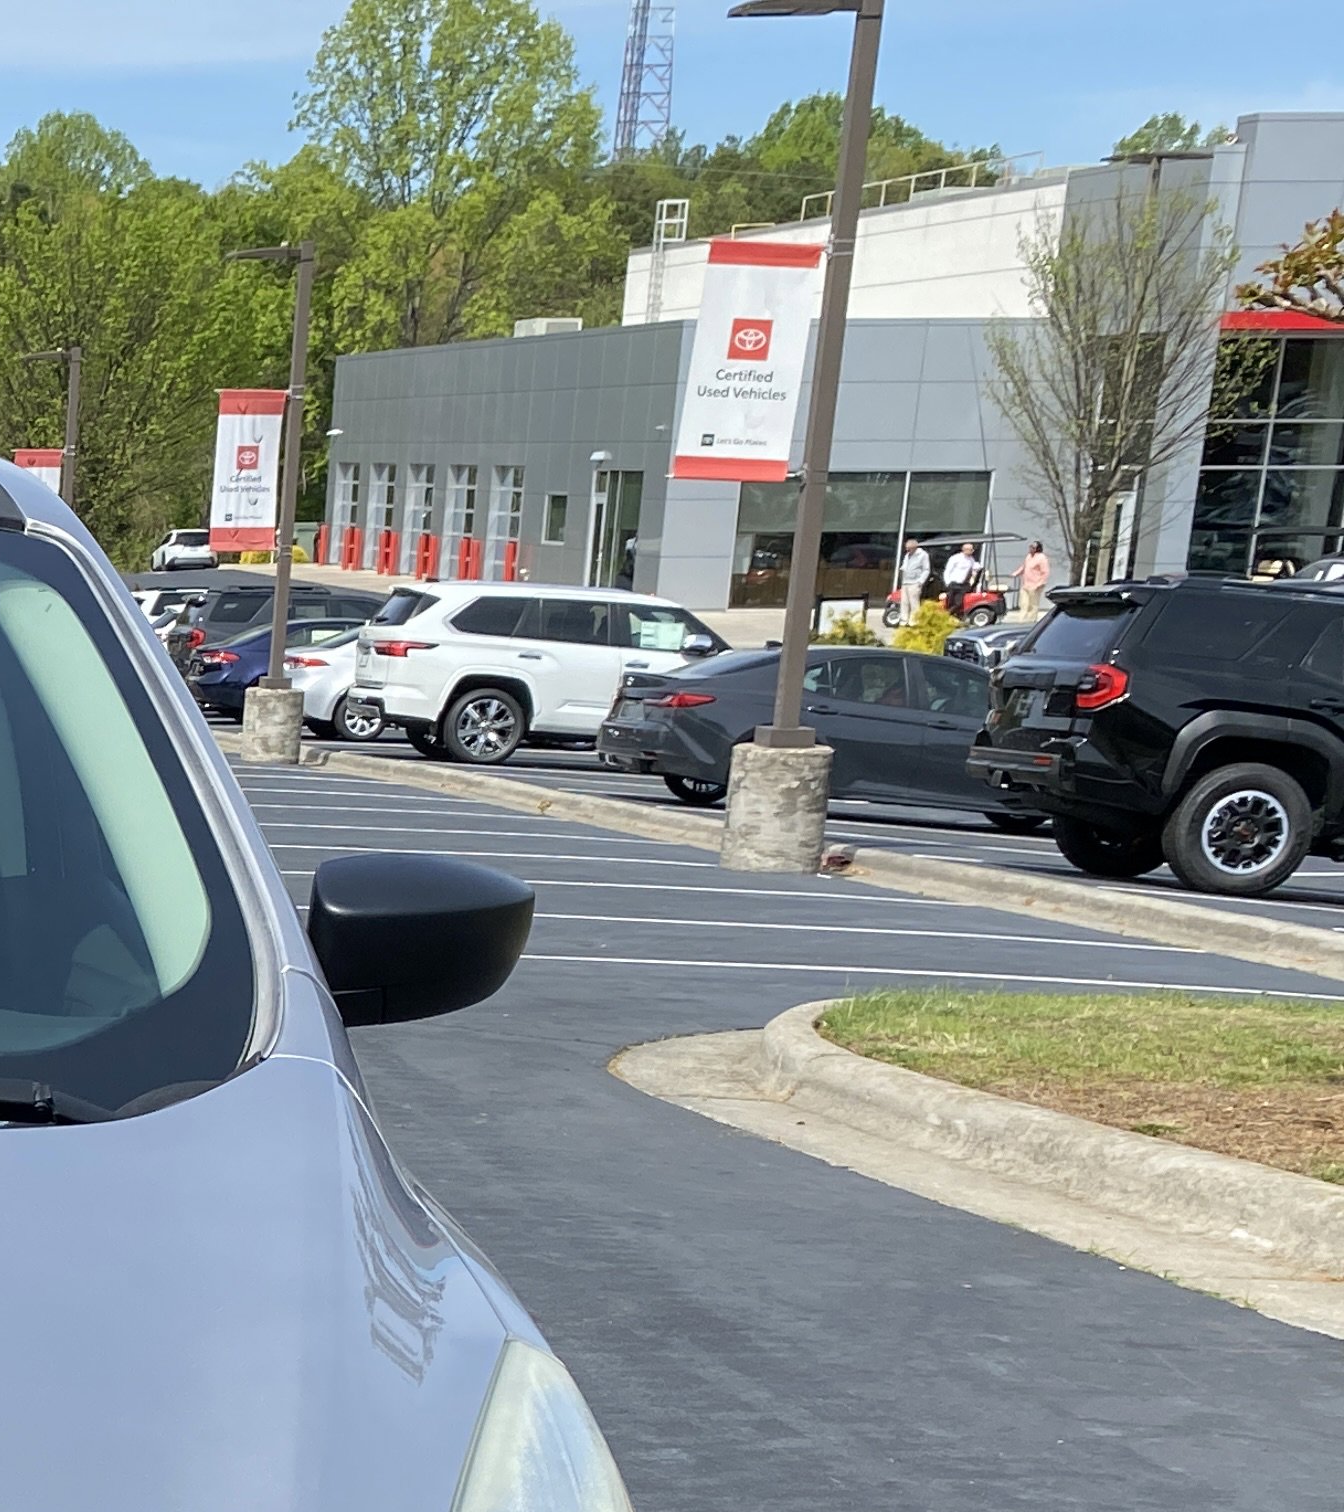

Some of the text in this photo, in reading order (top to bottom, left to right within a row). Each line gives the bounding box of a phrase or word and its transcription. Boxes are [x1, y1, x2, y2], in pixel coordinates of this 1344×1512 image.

[715, 368, 774, 383] Certified
[697, 385, 787, 401] Used Vehicles
